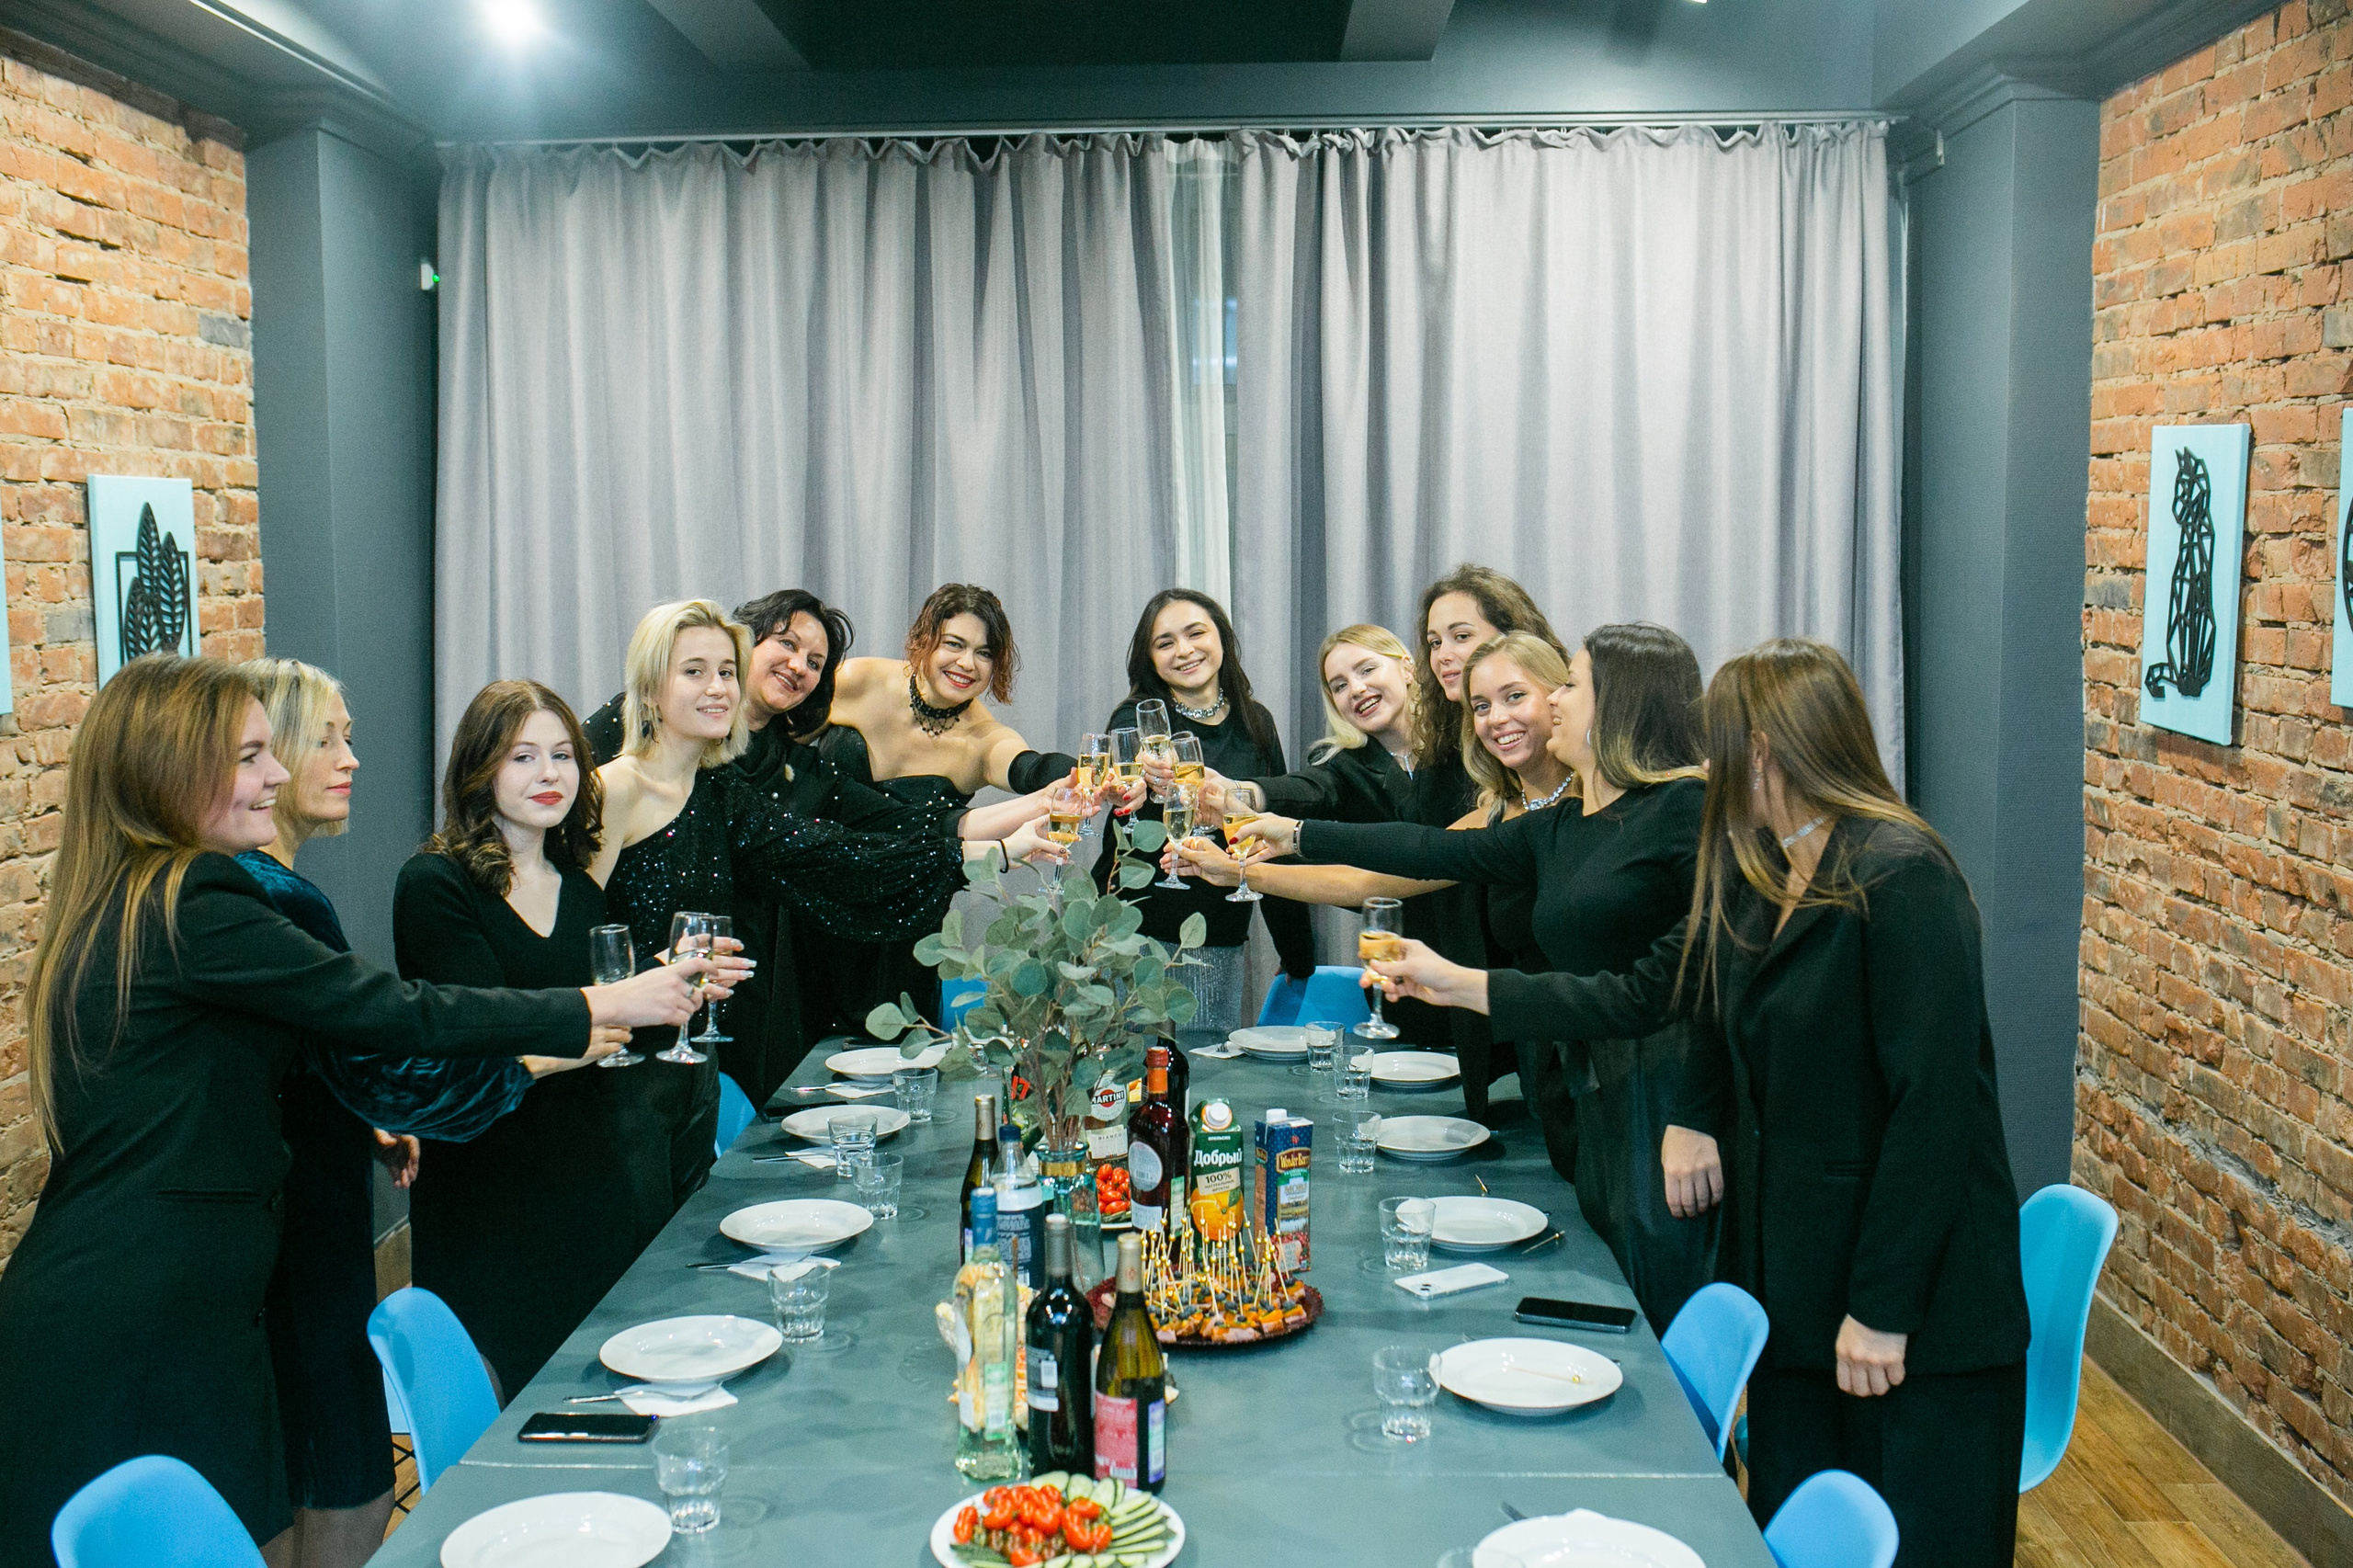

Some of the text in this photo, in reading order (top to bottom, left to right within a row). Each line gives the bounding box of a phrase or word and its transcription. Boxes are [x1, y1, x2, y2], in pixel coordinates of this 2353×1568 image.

[1092, 1091, 1124, 1104] MARTINI
[1194, 1148, 1242, 1167] Добрый
[1206, 1171, 1232, 1184] 100%
